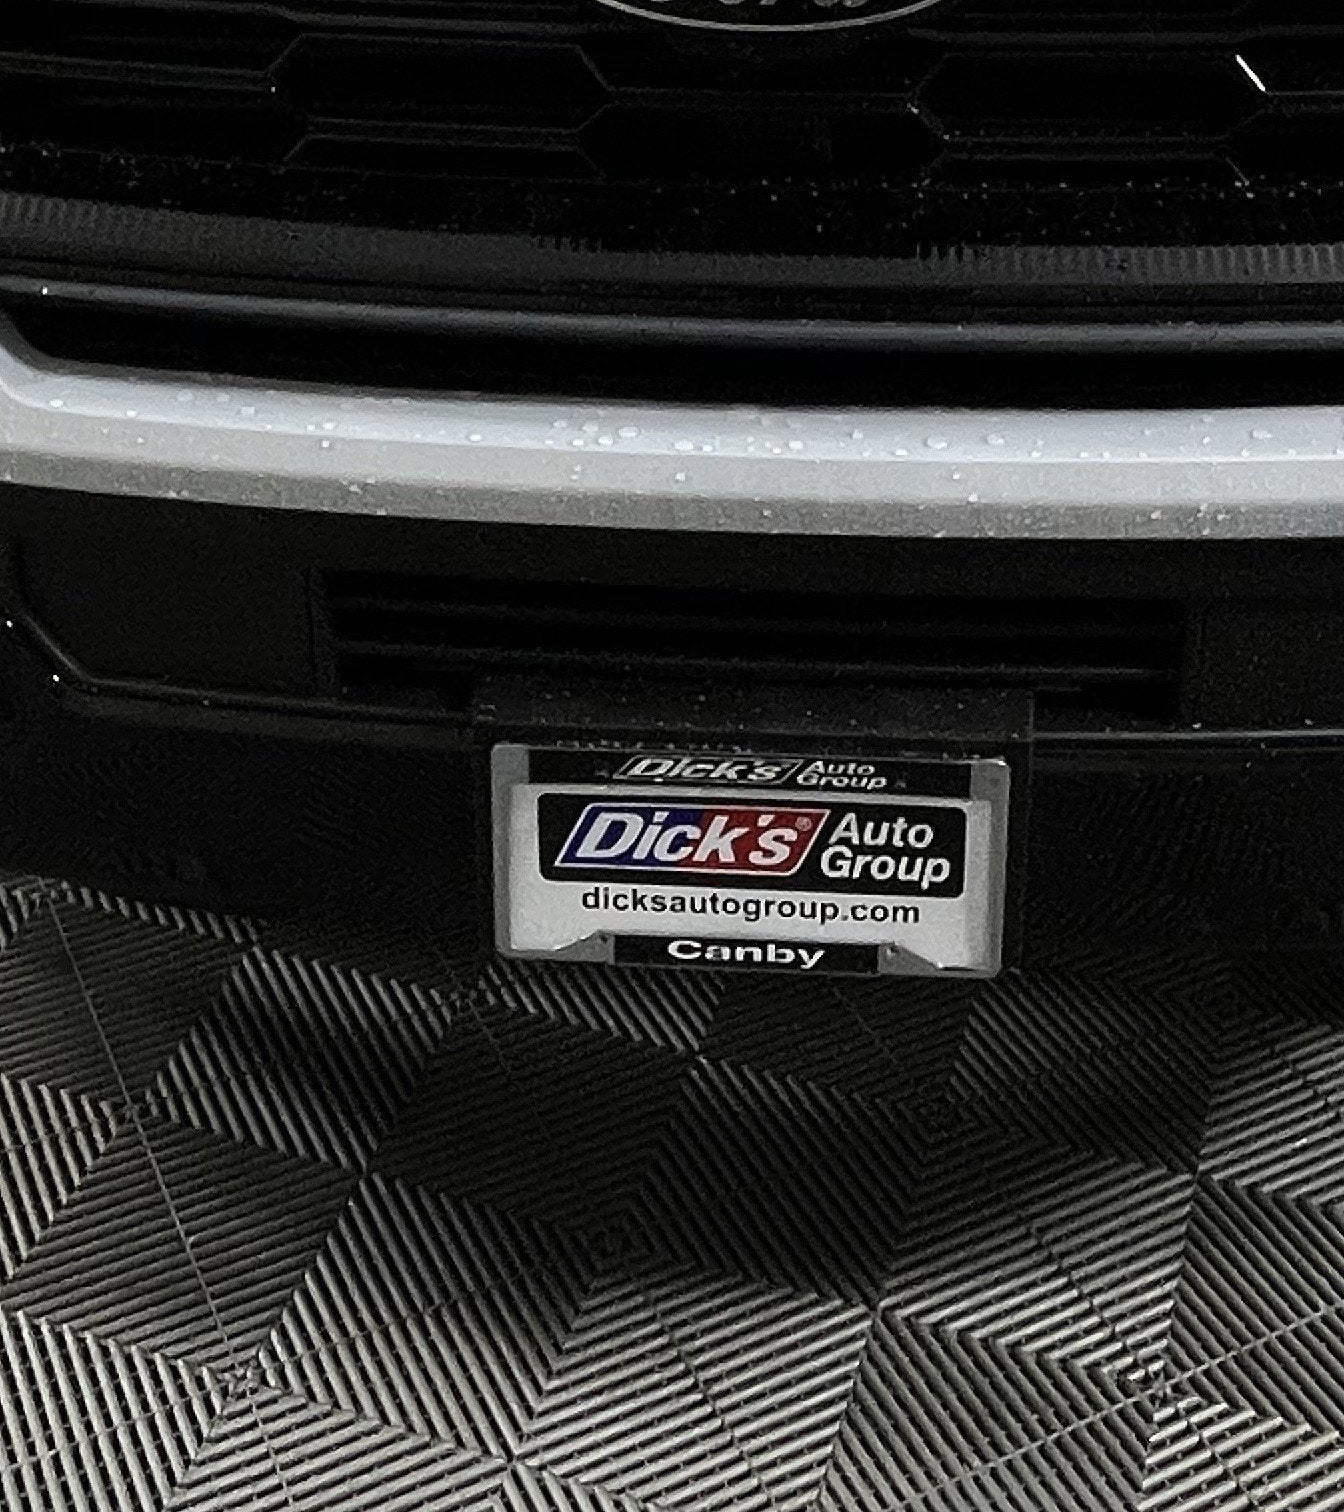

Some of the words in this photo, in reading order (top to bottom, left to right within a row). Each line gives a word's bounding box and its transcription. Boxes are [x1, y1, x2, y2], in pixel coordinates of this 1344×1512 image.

[626, 757, 783, 781] Dick's
[796, 774, 888, 790] Group
[802, 760, 876, 775] Auto
[575, 810, 800, 866] Dick's
[828, 812, 935, 849] Auto
[820, 844, 951, 890] Group
[581, 886, 921, 926] dicksautogroup.com
[666, 939, 826, 971] Canby
